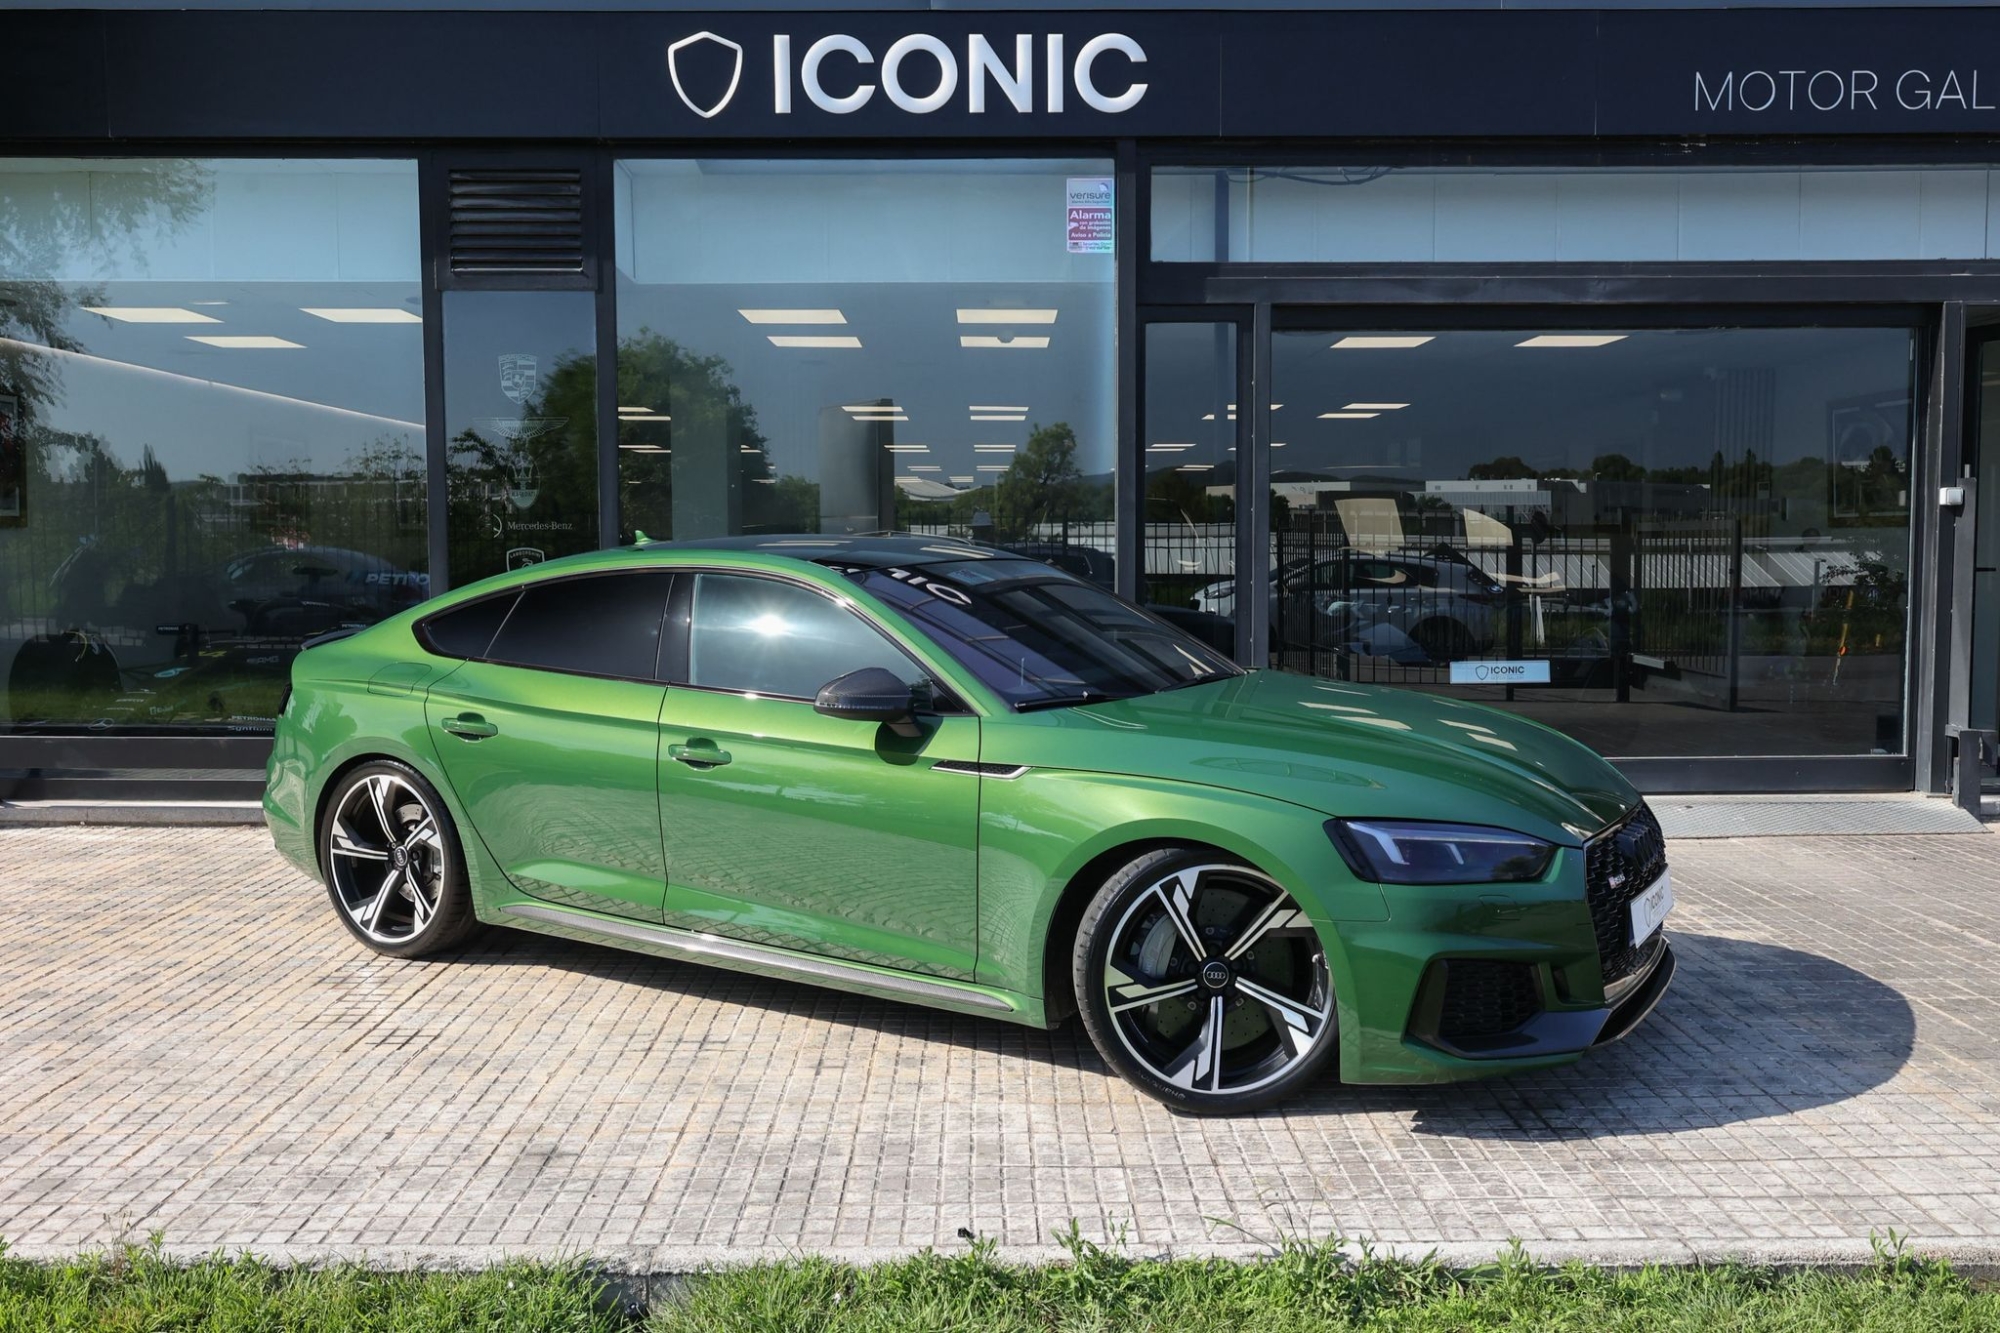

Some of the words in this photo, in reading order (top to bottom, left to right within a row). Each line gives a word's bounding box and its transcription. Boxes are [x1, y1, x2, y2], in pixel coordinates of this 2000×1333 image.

[773, 32, 1149, 114] ICONIC
[1694, 70, 1878, 111] MOTOR
[1895, 69, 1997, 110] GAL
[1070, 210, 1111, 219] Alarma
[507, 521, 573, 531] Mercedes-Benz
[1490, 666, 1525, 674] ICONIC
